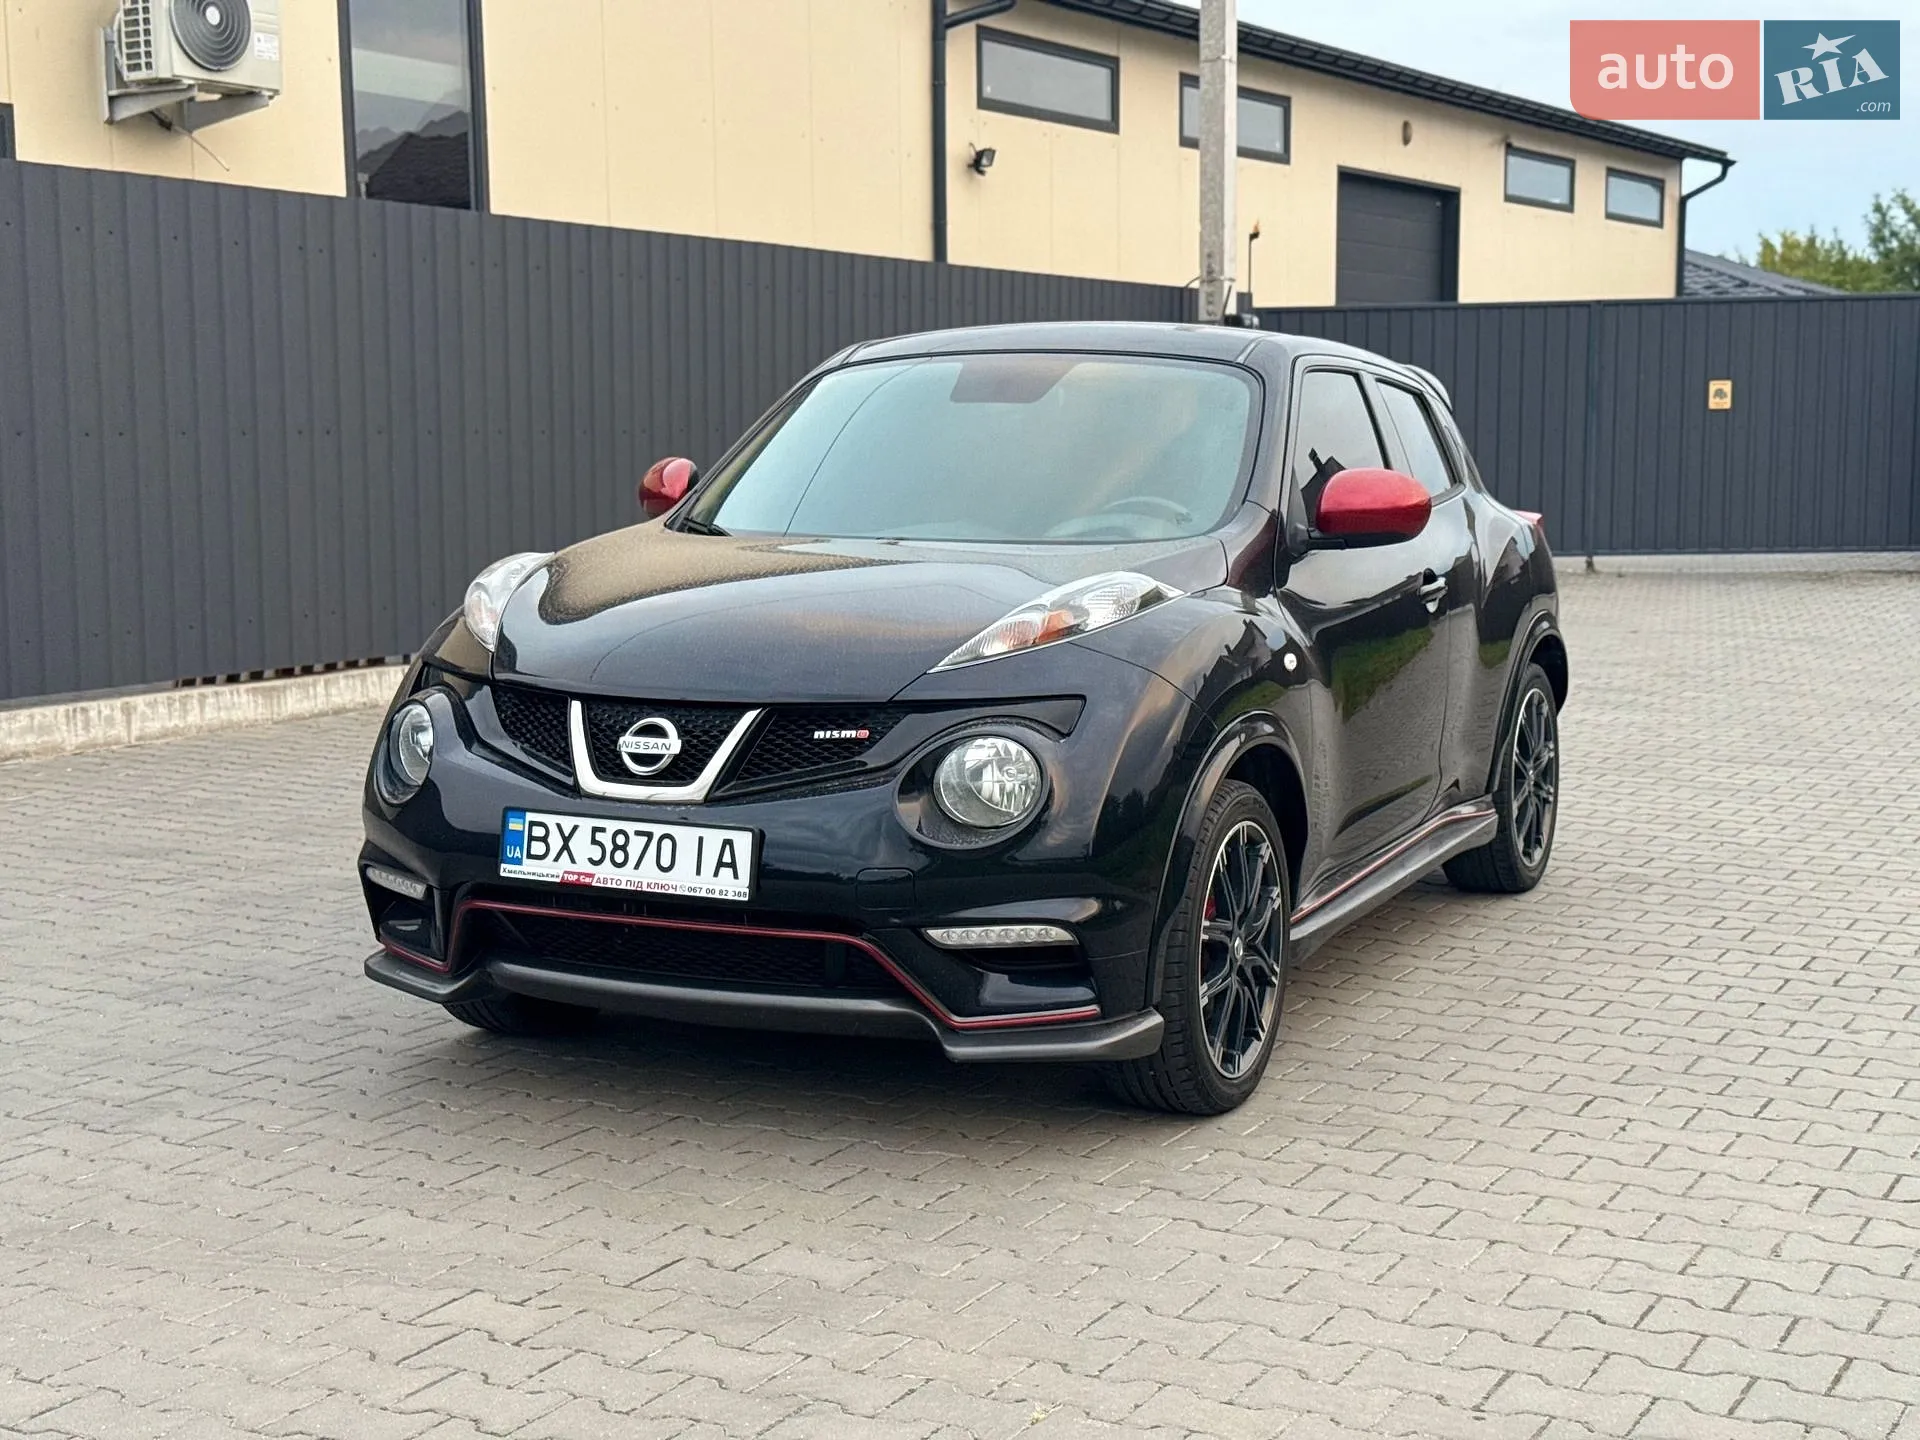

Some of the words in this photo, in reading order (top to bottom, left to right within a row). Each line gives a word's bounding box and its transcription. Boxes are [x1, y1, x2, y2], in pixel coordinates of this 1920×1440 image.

[621, 739, 671, 751] NISSAN
[507, 846, 522, 859] UA
[587, 826, 677, 873] 5870
[563, 873, 579, 881] TOP
[595, 876, 622, 886] АВТО
[625, 879, 643, 890] ПІД
[646, 881, 678, 892] КЛЮЧ
[687, 886, 703, 894] 067
[705, 888, 716, 896] 00
[718, 889, 729, 897] 82
